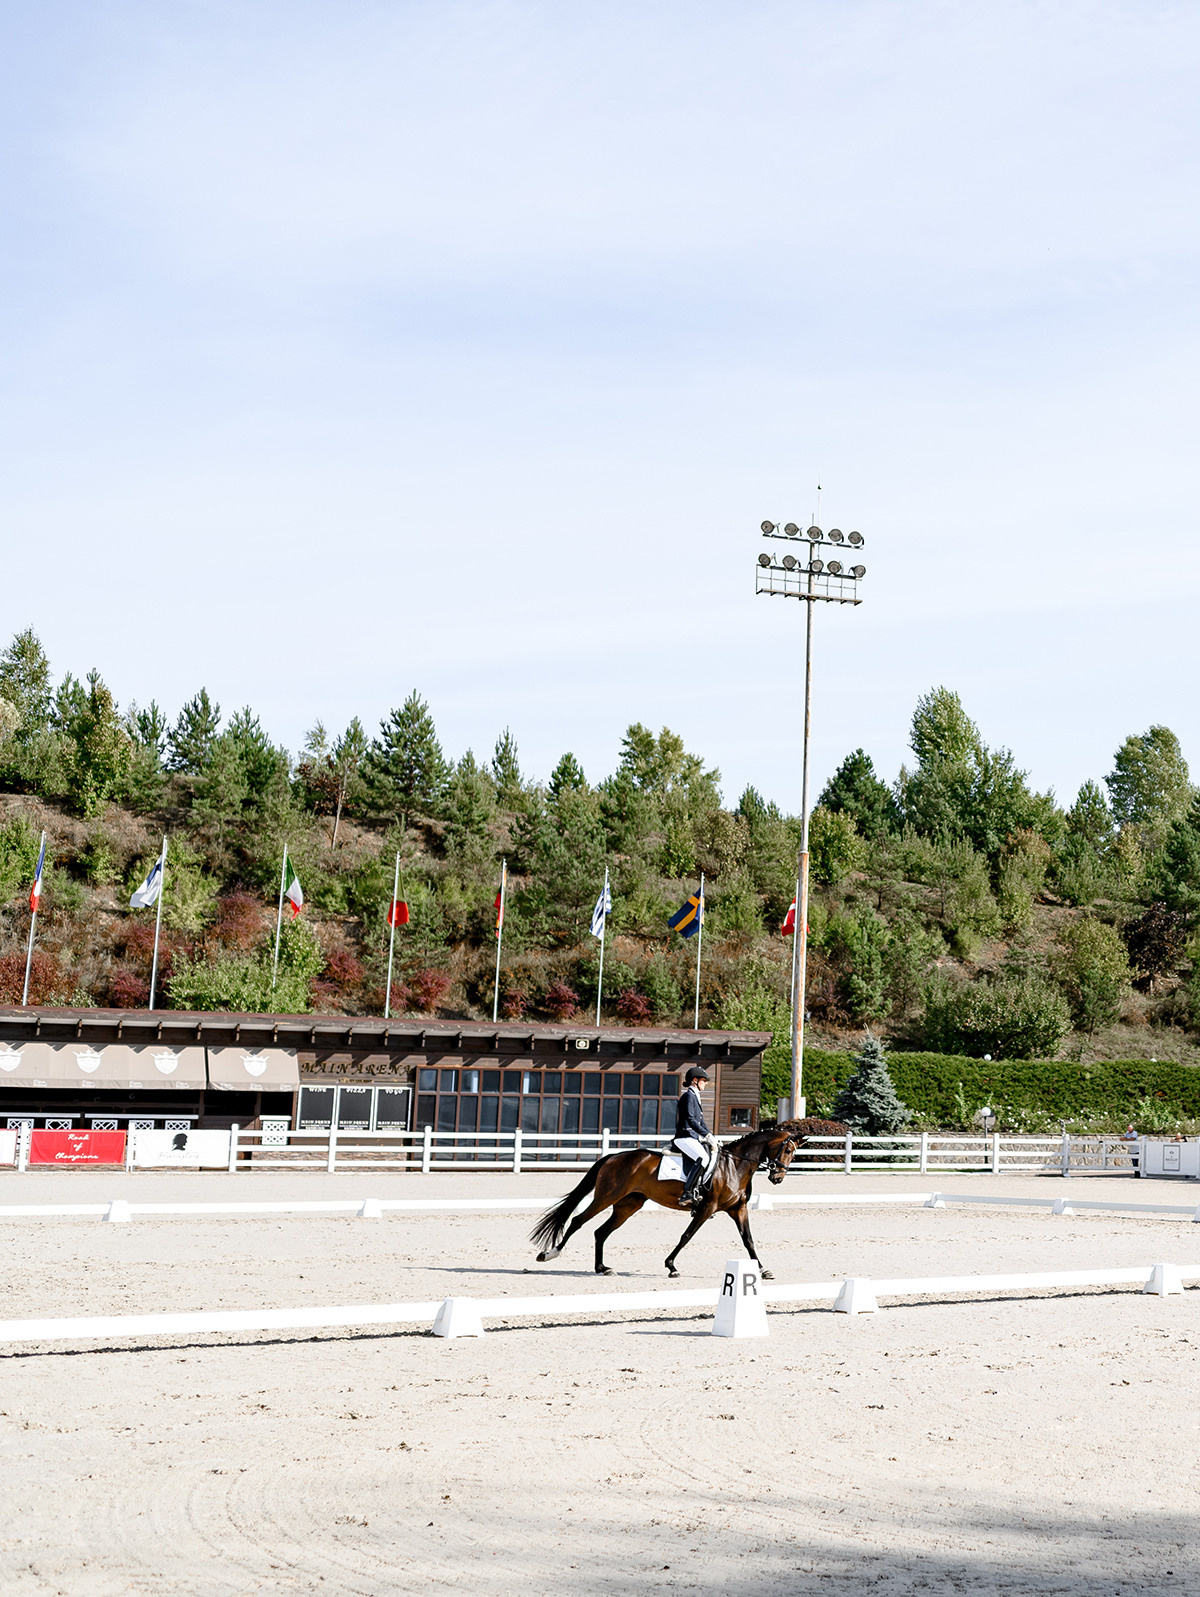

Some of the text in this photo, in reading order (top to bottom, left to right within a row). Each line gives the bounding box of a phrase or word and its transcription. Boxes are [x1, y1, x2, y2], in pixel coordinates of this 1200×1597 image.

[301, 1062, 412, 1076] MAIN ARENA
[73, 1142, 82, 1152] of
[55, 1152, 99, 1162] Champions
[722, 1272, 735, 1297] R
[742, 1273, 758, 1297] R
